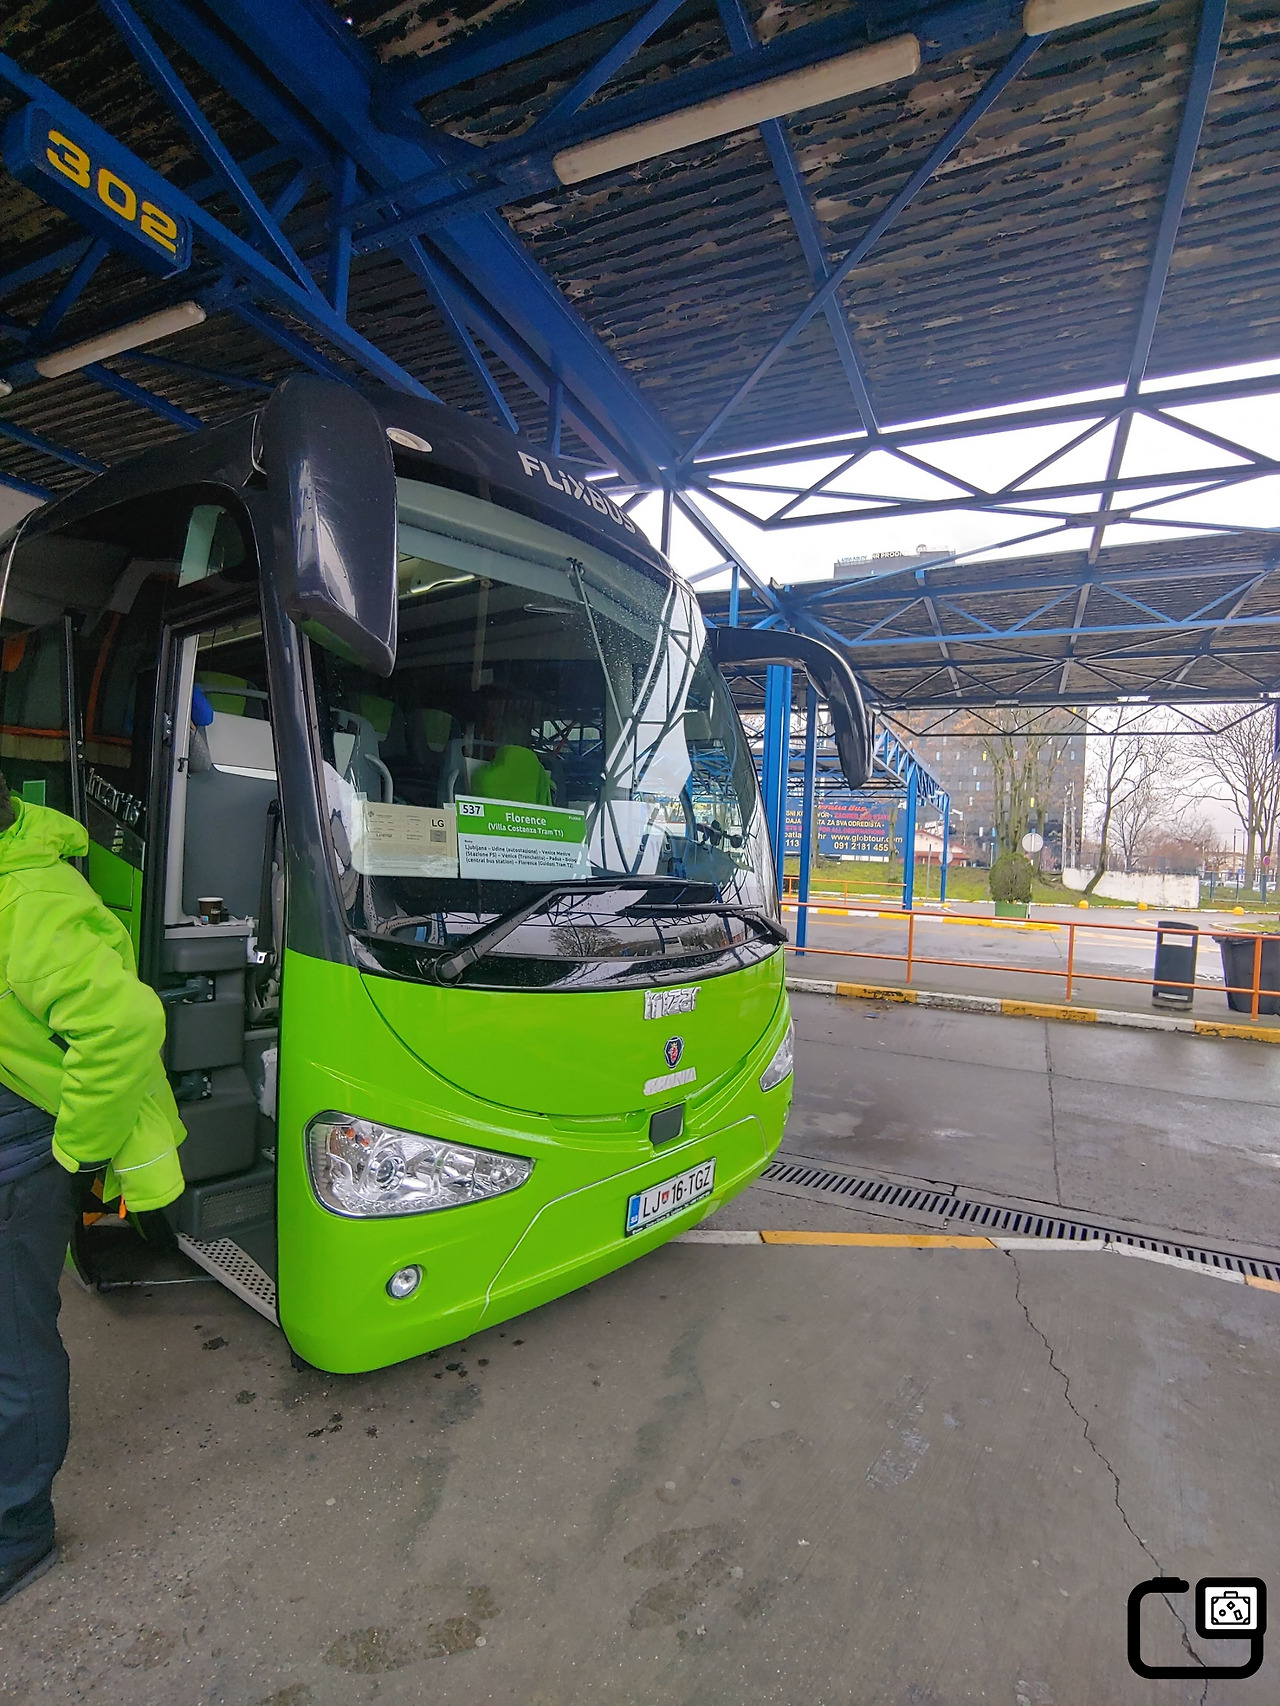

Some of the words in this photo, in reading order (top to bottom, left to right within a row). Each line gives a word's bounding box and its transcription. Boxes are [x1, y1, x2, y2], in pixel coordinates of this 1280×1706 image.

[47, 129, 177, 253] 302
[463, 805, 481, 815] 537
[431, 819, 445, 828] LG
[505, 812, 547, 826] Florence
[488, 823, 507, 832] (Villa
[507, 825, 537, 834] Costanza
[537, 828, 554, 836] Tram
[554, 829, 564, 838] T1)
[831, 834, 903, 843] www.globtour.cm
[785, 839, 800, 847] 113
[834, 841, 848, 850] 091
[851, 842, 871, 851] 2181
[873, 843, 889, 852] 455
[643, 1191, 661, 1218] LJ
[672, 1166, 711, 1204] 16-TGZ
